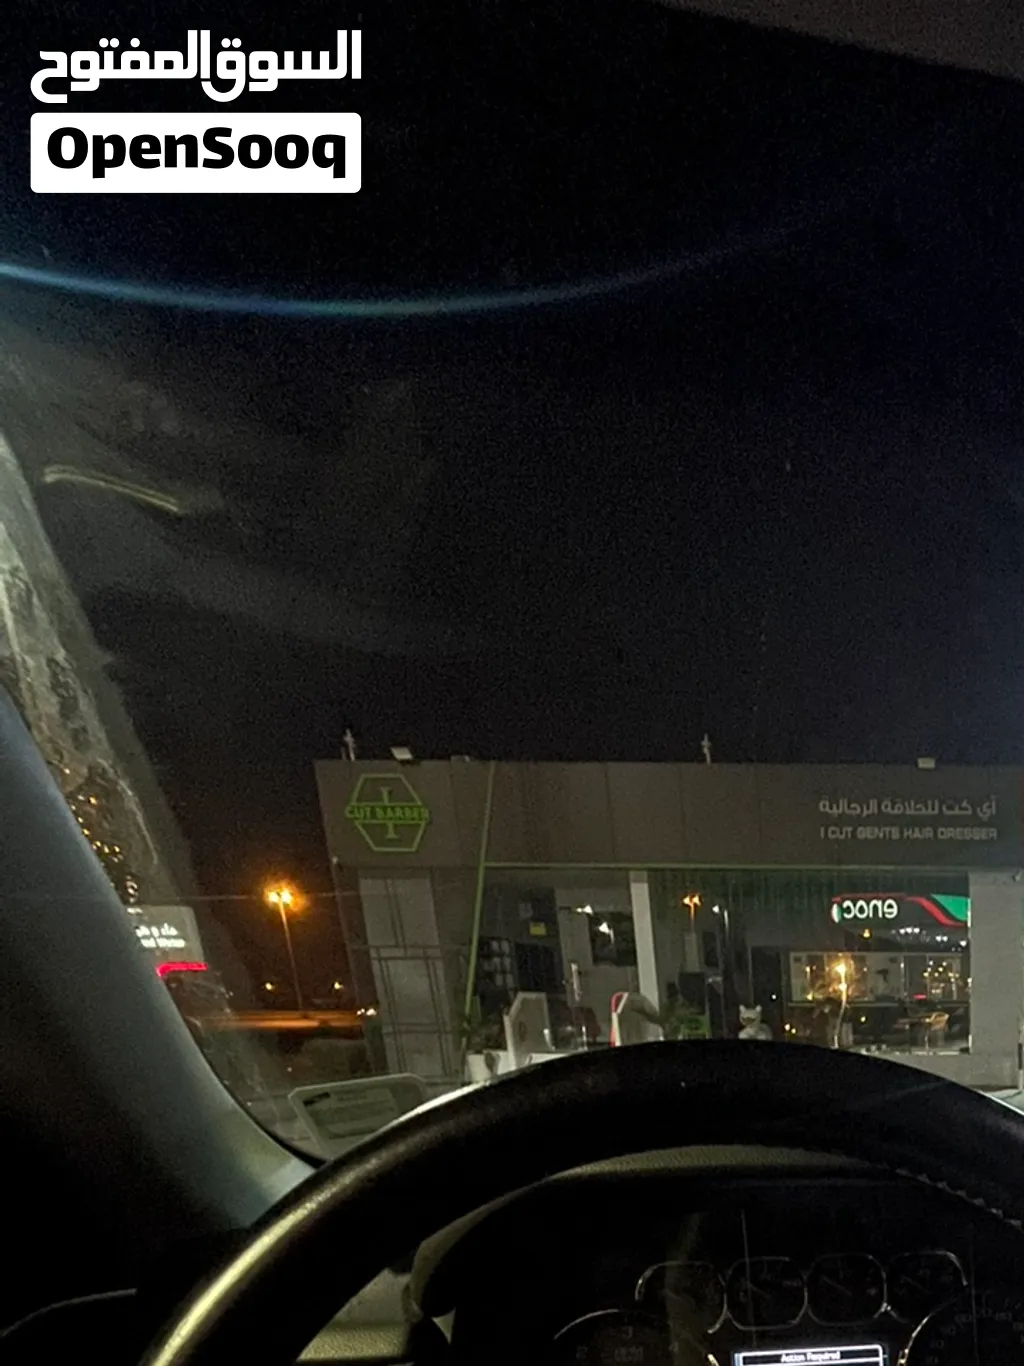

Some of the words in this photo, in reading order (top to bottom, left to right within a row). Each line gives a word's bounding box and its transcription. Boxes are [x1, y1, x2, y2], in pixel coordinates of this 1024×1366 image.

[881, 797, 939, 816] للحلاقة
[828, 826, 852, 839] CUT
[856, 826, 899, 840] GENTS
